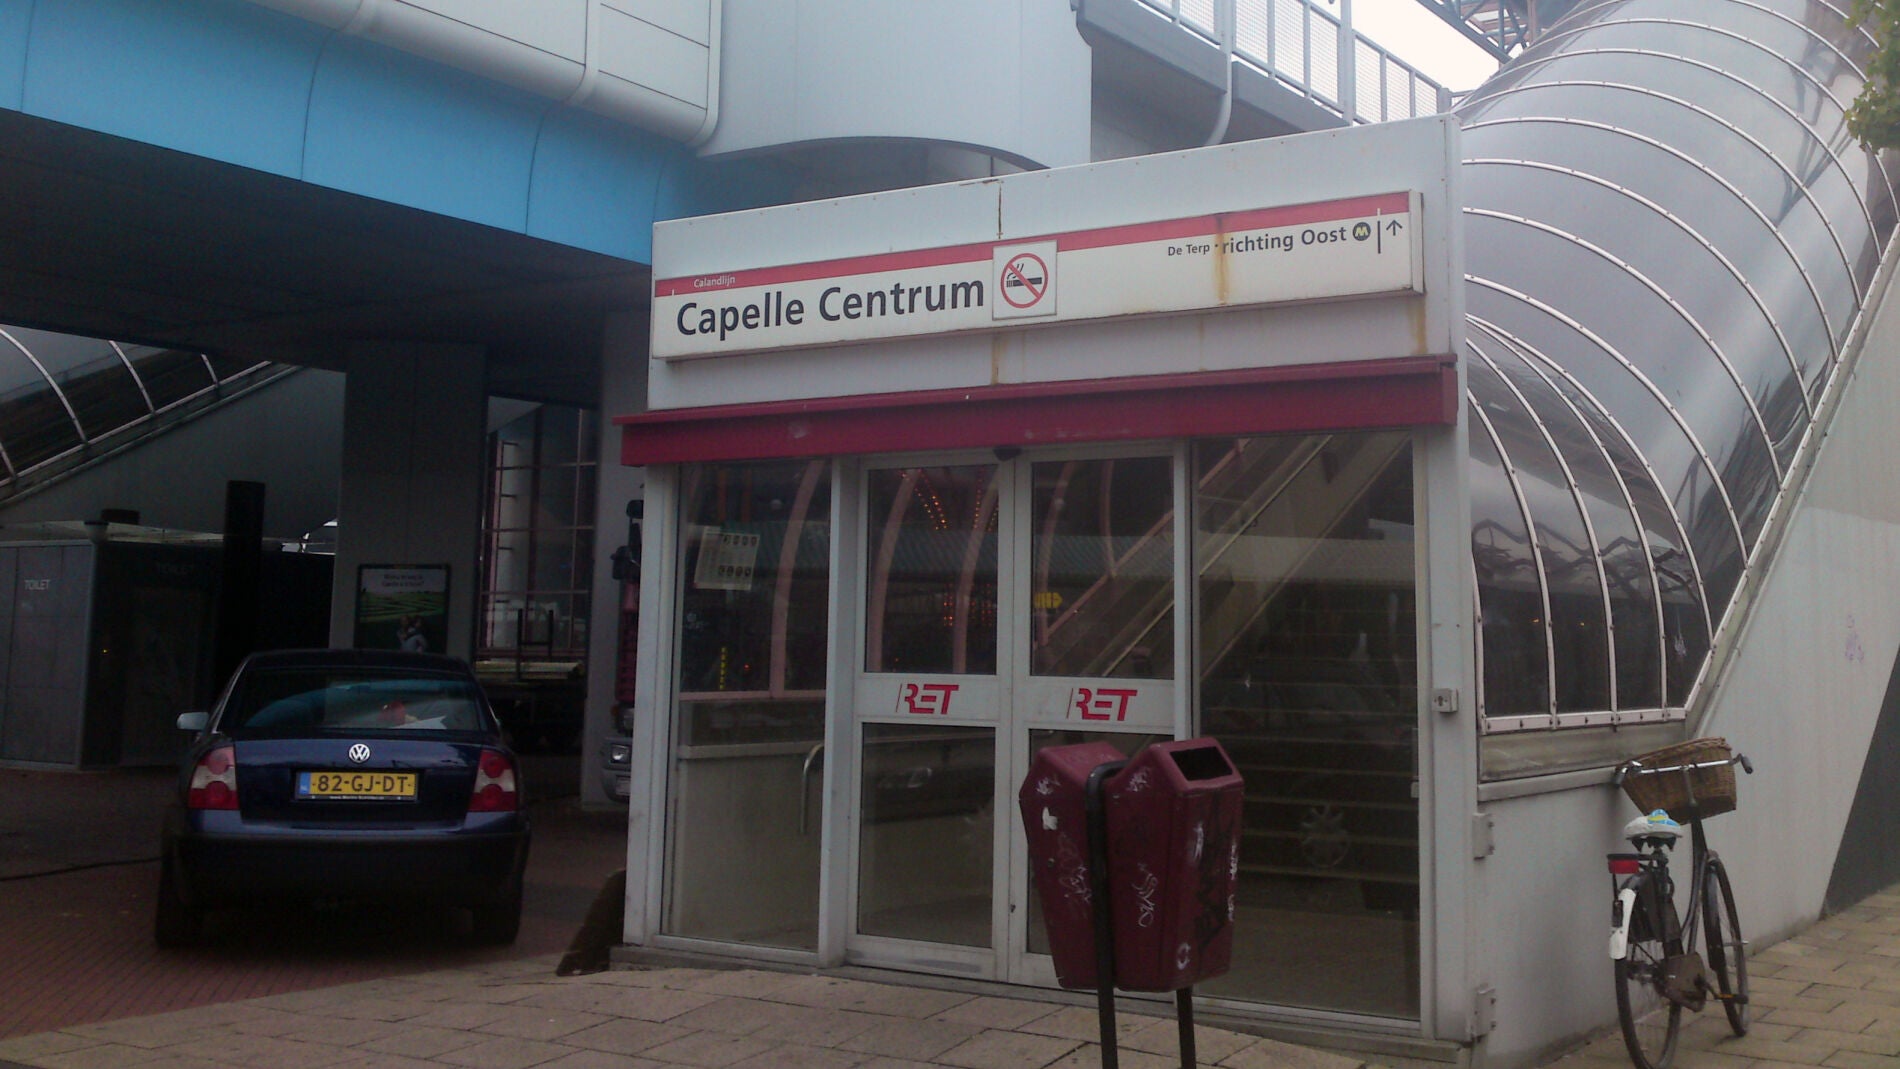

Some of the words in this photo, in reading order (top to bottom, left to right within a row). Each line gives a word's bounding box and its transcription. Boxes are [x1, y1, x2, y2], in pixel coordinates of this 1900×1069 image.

[1167, 245, 1183, 257] De
[1186, 242, 1211, 256] Terp
[1222, 232, 1294, 255] richting
[1301, 225, 1347, 246] Oost
[693, 274, 736, 289] Calandlijn
[677, 290, 805, 341] Capelle
[819, 278, 984, 322] Centrum
[24, 579, 51, 591] TOILET
[903, 683, 960, 715] RET
[1074, 687, 1138, 722] RET
[317, 774, 409, 793] 82-GJ-DT
